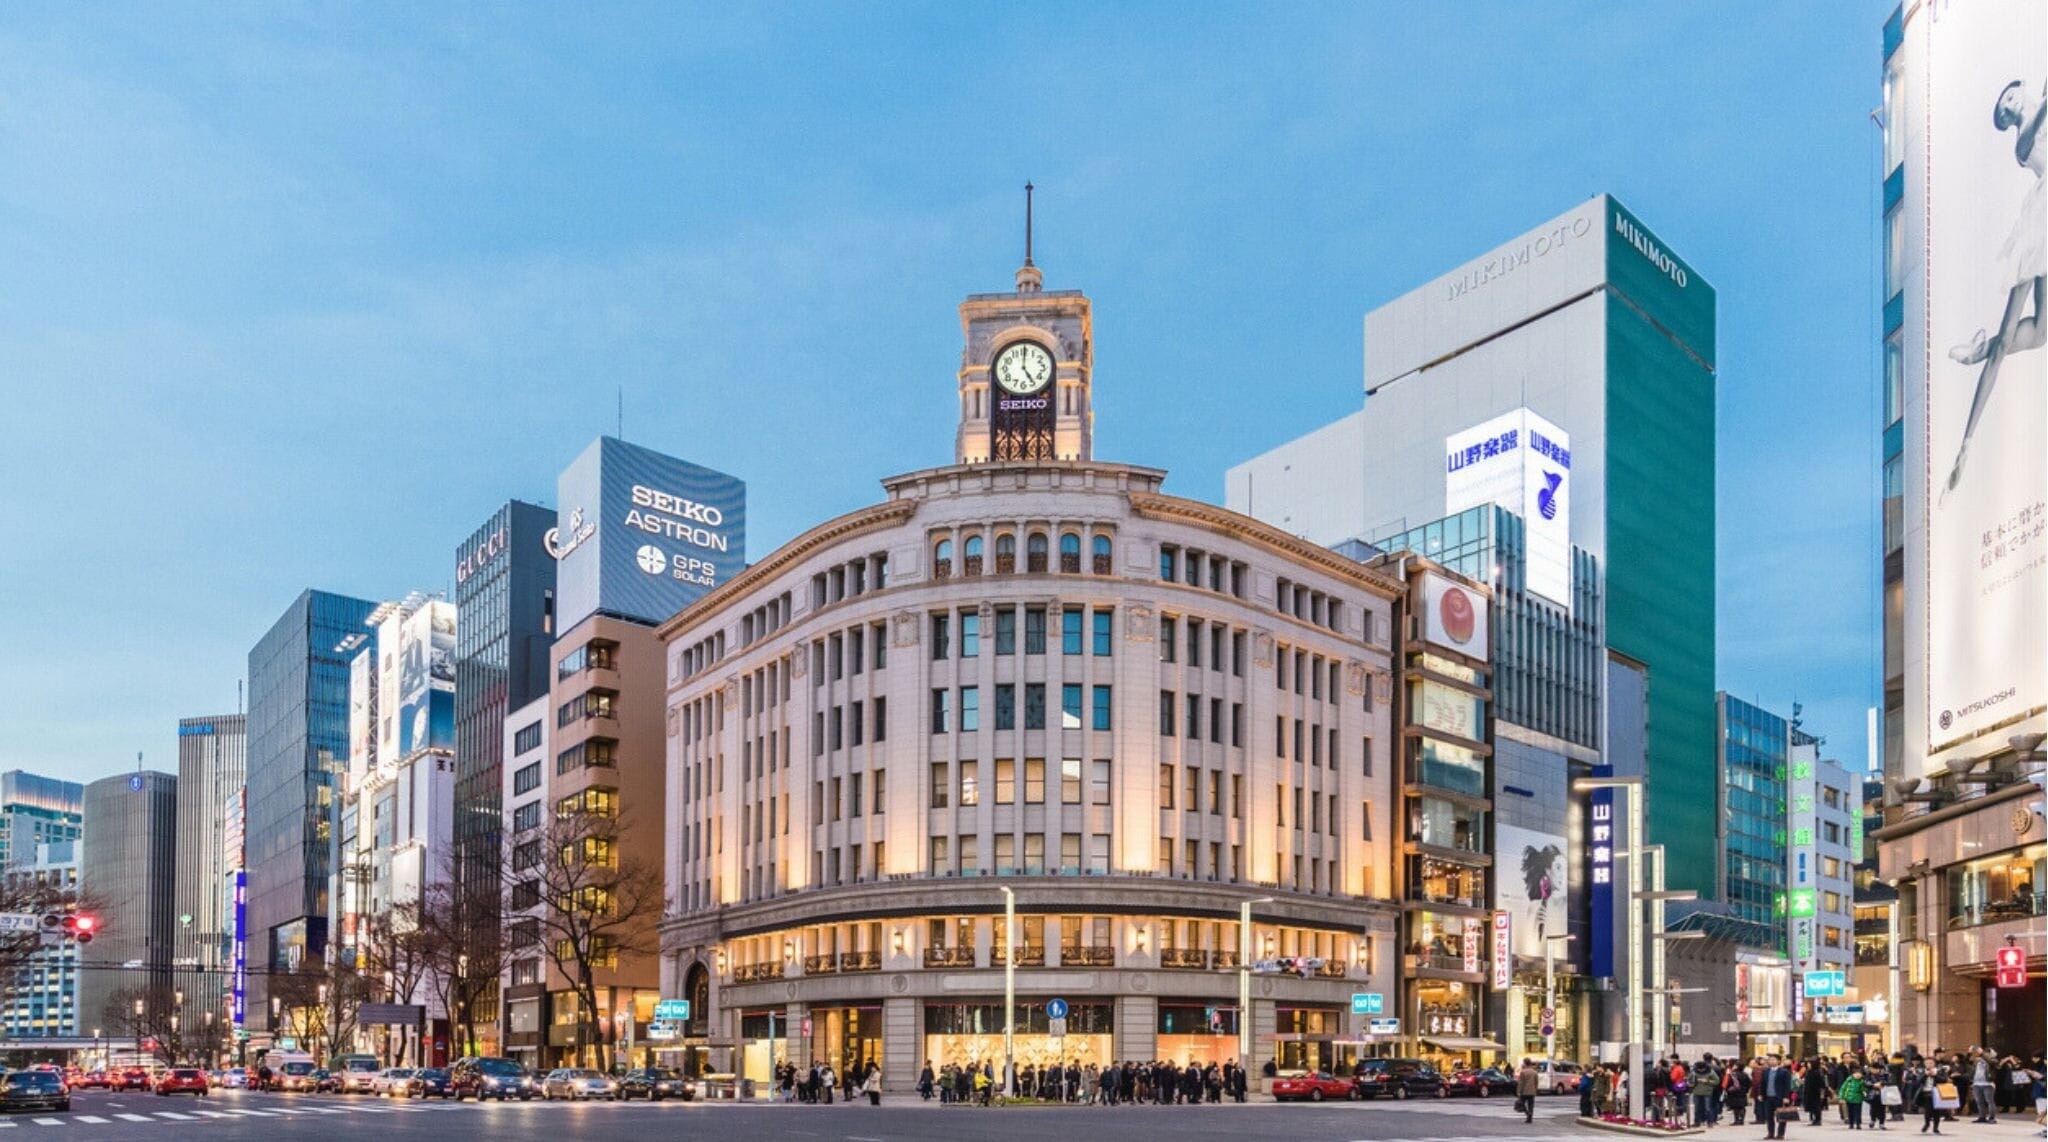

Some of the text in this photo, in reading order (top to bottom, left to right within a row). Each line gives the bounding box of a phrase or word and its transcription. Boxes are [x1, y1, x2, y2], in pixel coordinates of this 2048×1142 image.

[1448, 217, 1592, 300] MIKIMOTO
[1615, 211, 1687, 289] MIKIMOTO
[1005, 373, 1011, 381] 8
[1012, 379, 1019, 388] 7
[1020, 381, 1027, 390] 6
[1000, 399, 1047, 410] SEIKO
[1447, 429, 1518, 473] 山野楽器
[1529, 429, 1571, 470] 山野楽器
[631, 484, 723, 527] SEIKO
[624, 508, 728, 553] ASTRON
[456, 527, 507, 583] GUCCI
[672, 554, 716, 577] GPS
[672, 569, 716, 588] SOLAR
[1957, 686, 2016, 718] MITSUKOSHI
